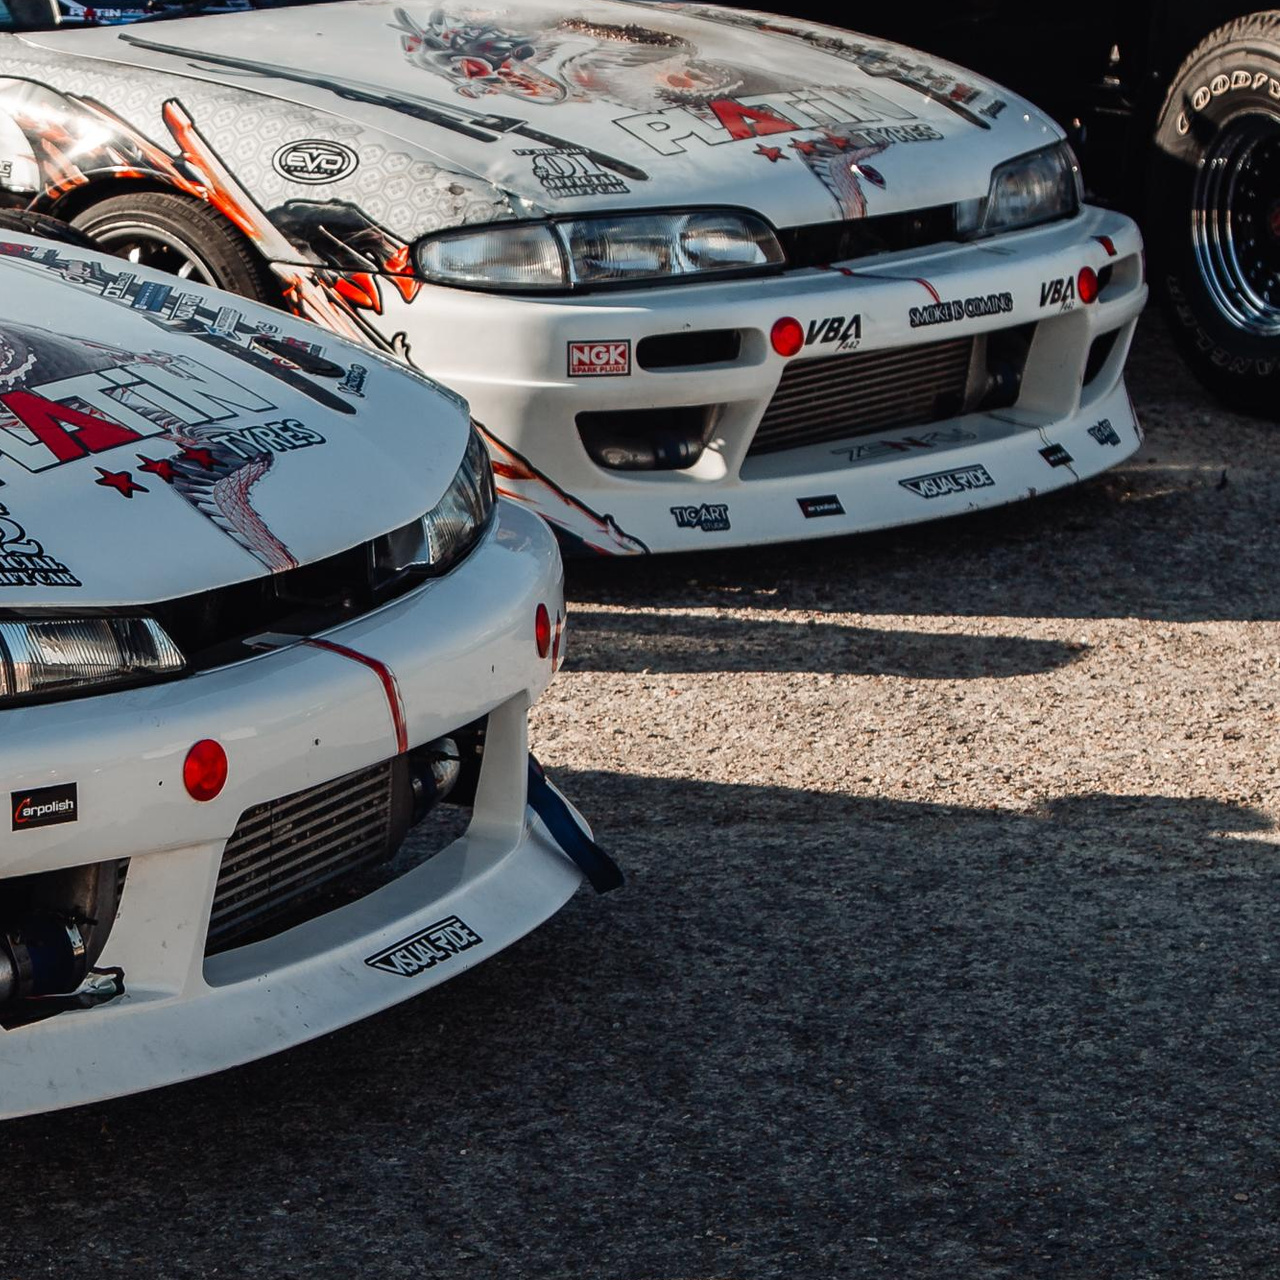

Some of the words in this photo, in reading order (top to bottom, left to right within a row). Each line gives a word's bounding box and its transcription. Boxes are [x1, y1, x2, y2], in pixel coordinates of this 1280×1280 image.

[849, 123, 944, 145] TYRES
[1039, 276, 1075, 308] VBA
[964, 292, 1014, 318] COMING
[804, 314, 862, 347] VBA
[571, 345, 627, 366] NGK
[841, 340, 860, 351] 442
[571, 365, 598, 374] SPARK
[599, 364, 627, 373] PLUGS
[212, 418, 327, 458] TYRES
[34, 570, 82, 586] CAR
